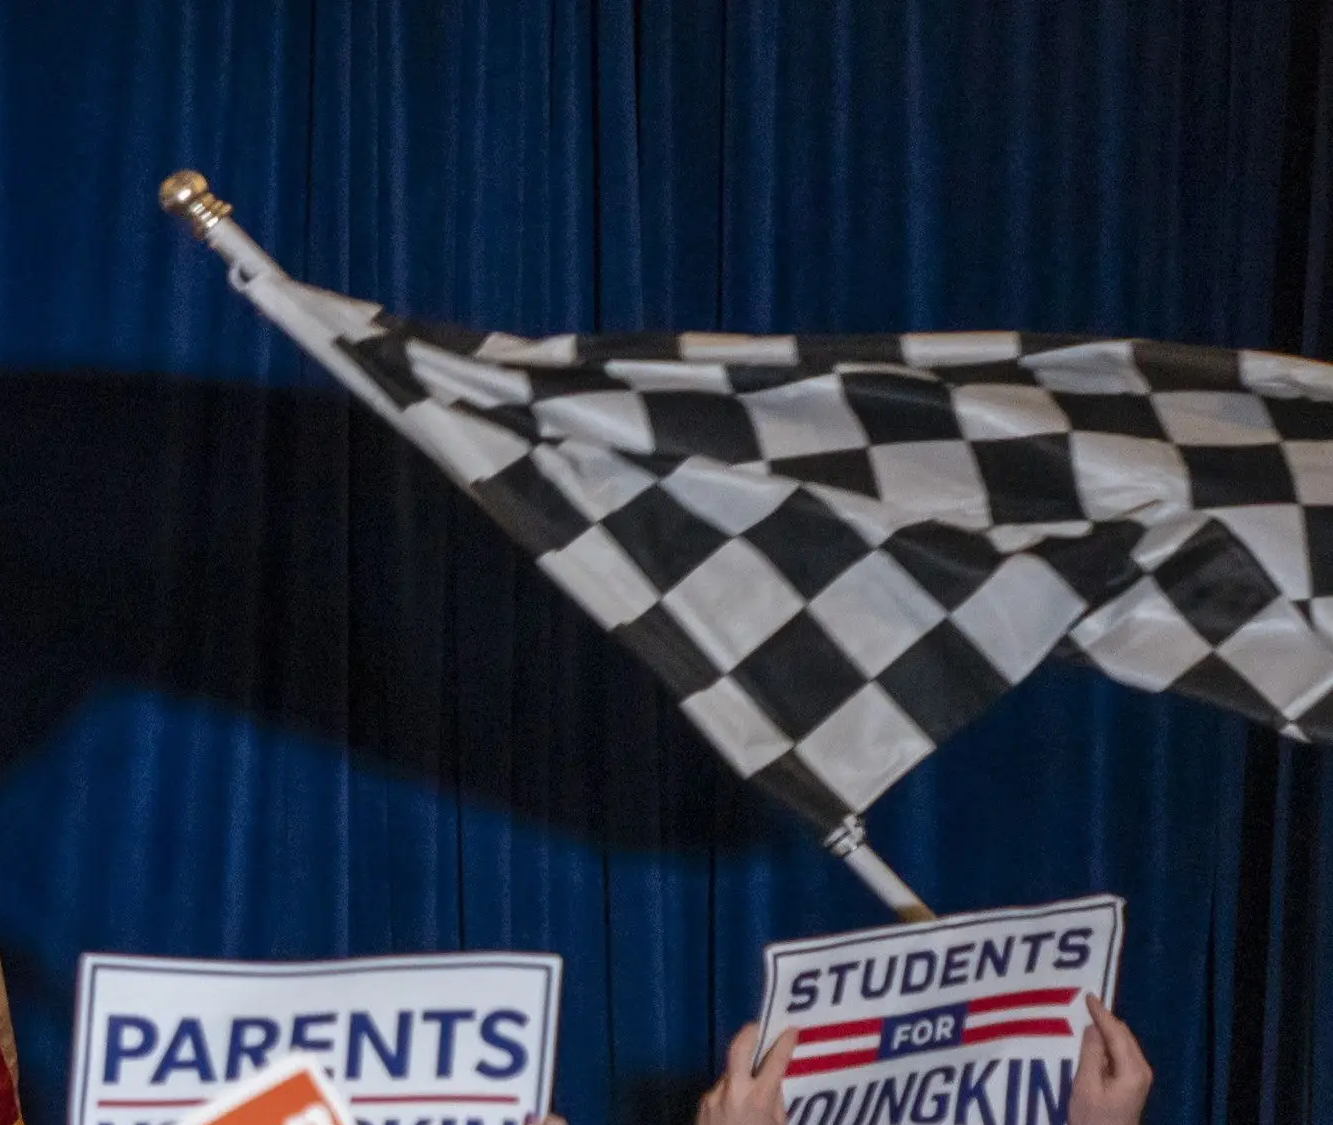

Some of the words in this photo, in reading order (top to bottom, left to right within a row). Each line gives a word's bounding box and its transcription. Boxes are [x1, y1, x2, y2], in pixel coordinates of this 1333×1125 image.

[786, 927, 1093, 1014] STUDENTS
[102, 1009, 530, 1086] PARENTS
[892, 1015, 956, 1051] FOR
